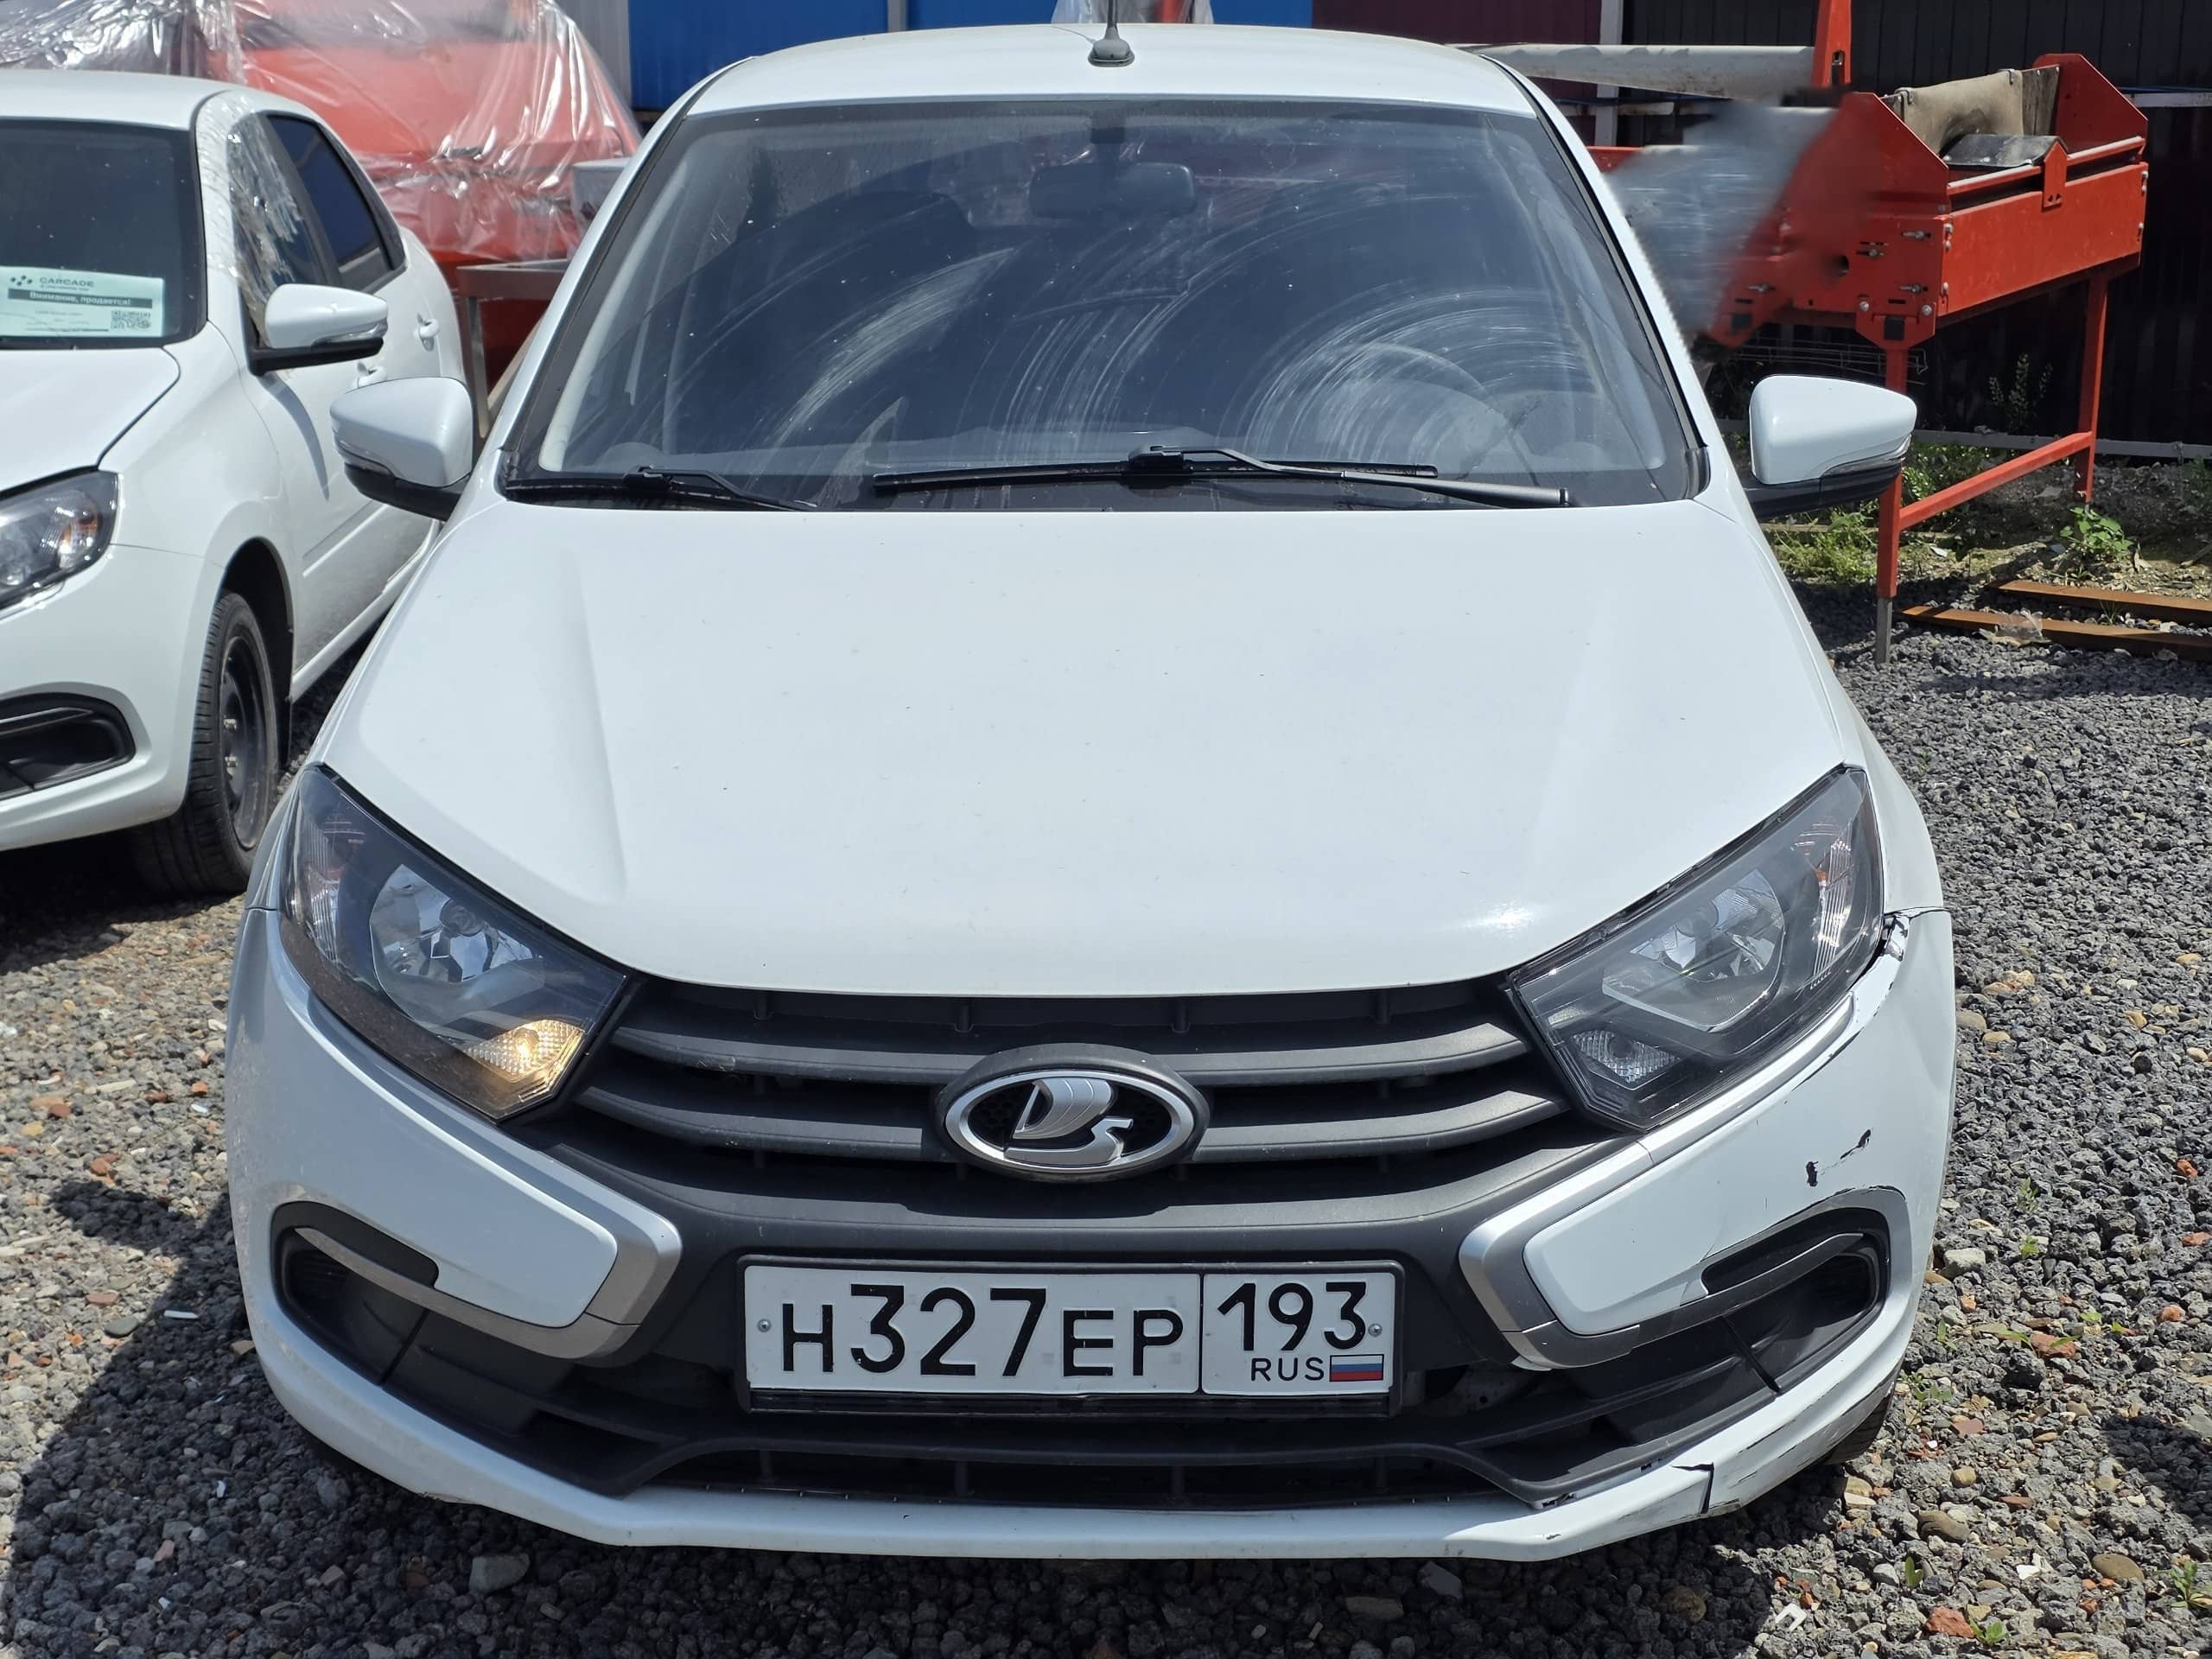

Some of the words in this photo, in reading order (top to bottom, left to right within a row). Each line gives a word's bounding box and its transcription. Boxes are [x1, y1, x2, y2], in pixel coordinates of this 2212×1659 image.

[40, 277, 94, 288] CARCADE
[29, 291, 79, 304] Внимание,
[1217, 1281, 1367, 1352] 193
[1250, 1357, 1324, 1382] RUS
